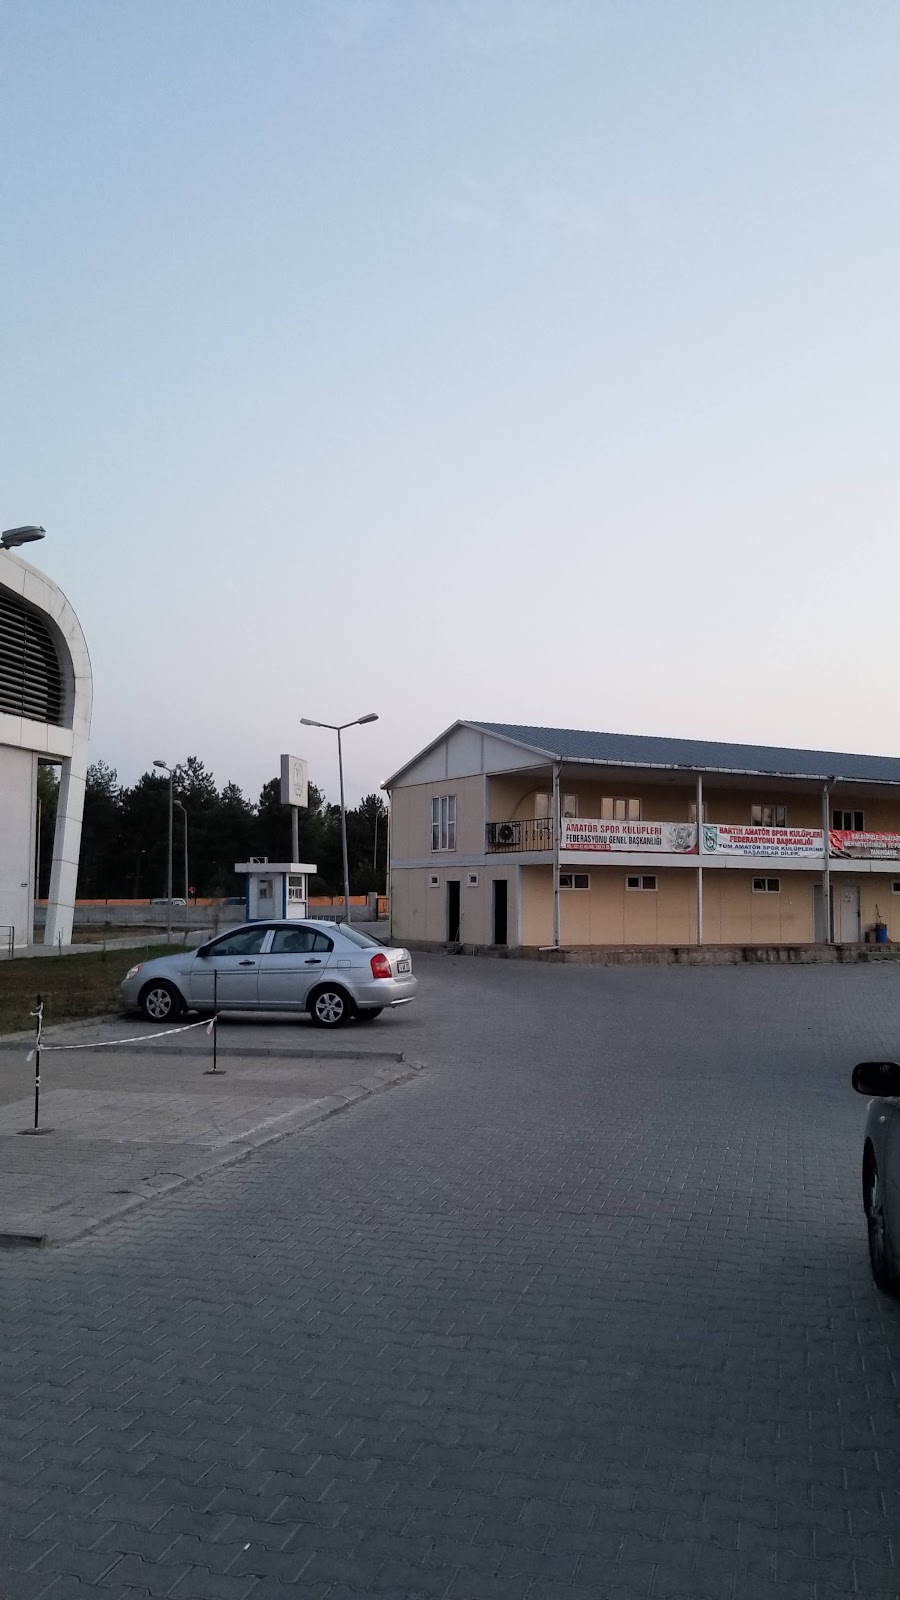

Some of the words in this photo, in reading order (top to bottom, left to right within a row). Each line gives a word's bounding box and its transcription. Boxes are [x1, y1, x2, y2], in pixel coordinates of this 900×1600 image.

[566, 822, 598, 832] AMATÖR
[600, 824, 620, 834] SPOR
[622, 825, 662, 835] KULÜPLERİ
[719, 826, 743, 835] BARTIN
[745, 827, 770, 836] AMATÖR
[771, 829, 789, 837] SPOR
[789, 830, 823, 839] KULÜPLERİ
[566, 834, 608, 844] FEDERASYONU
[609, 836, 627, 844] GENEL
[629, 836, 662, 847] BAŞKANLIĞI
[729, 835, 775, 845] FEDERASYONU
[776, 837, 814, 847] BAŞKANLIĞI
